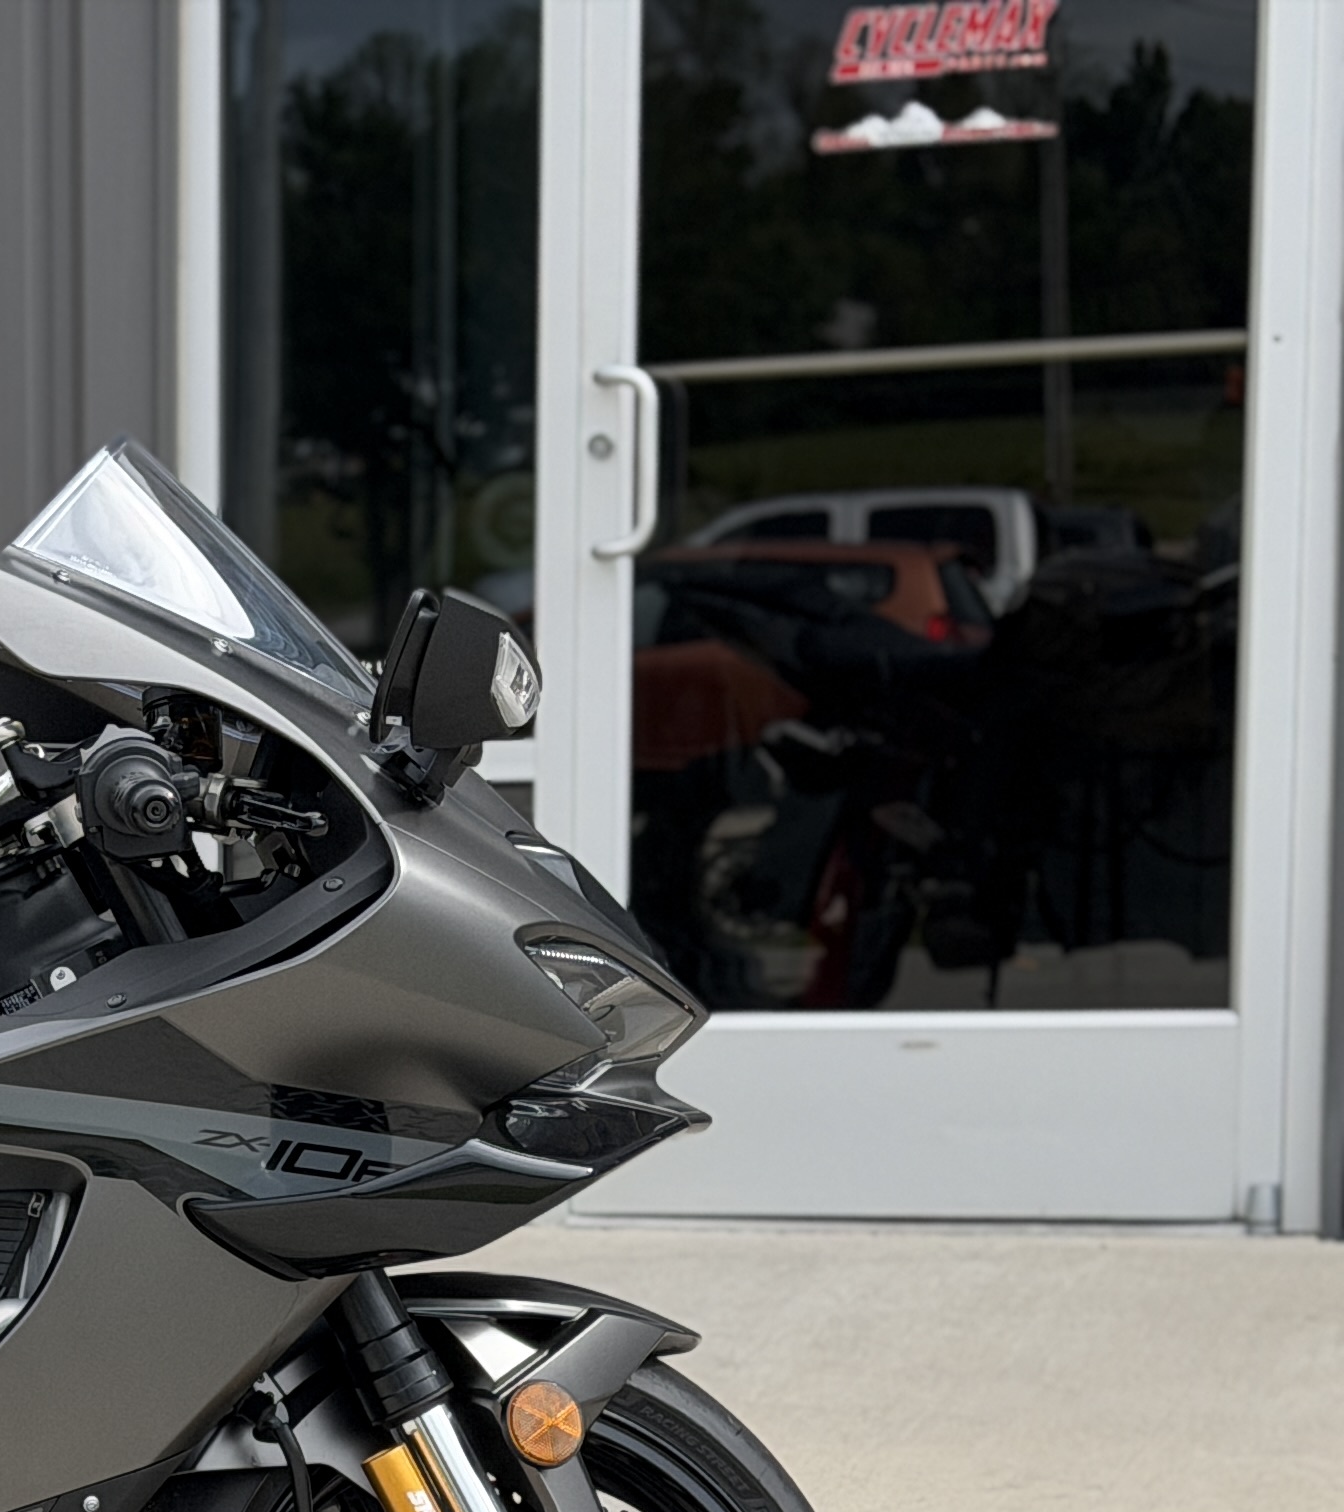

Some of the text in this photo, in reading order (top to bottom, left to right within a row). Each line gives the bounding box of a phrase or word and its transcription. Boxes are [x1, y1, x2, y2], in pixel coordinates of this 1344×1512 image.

[834, 0, 1058, 60] CYCLEMAX
[639, 1405, 751, 1492] RACING STREET
